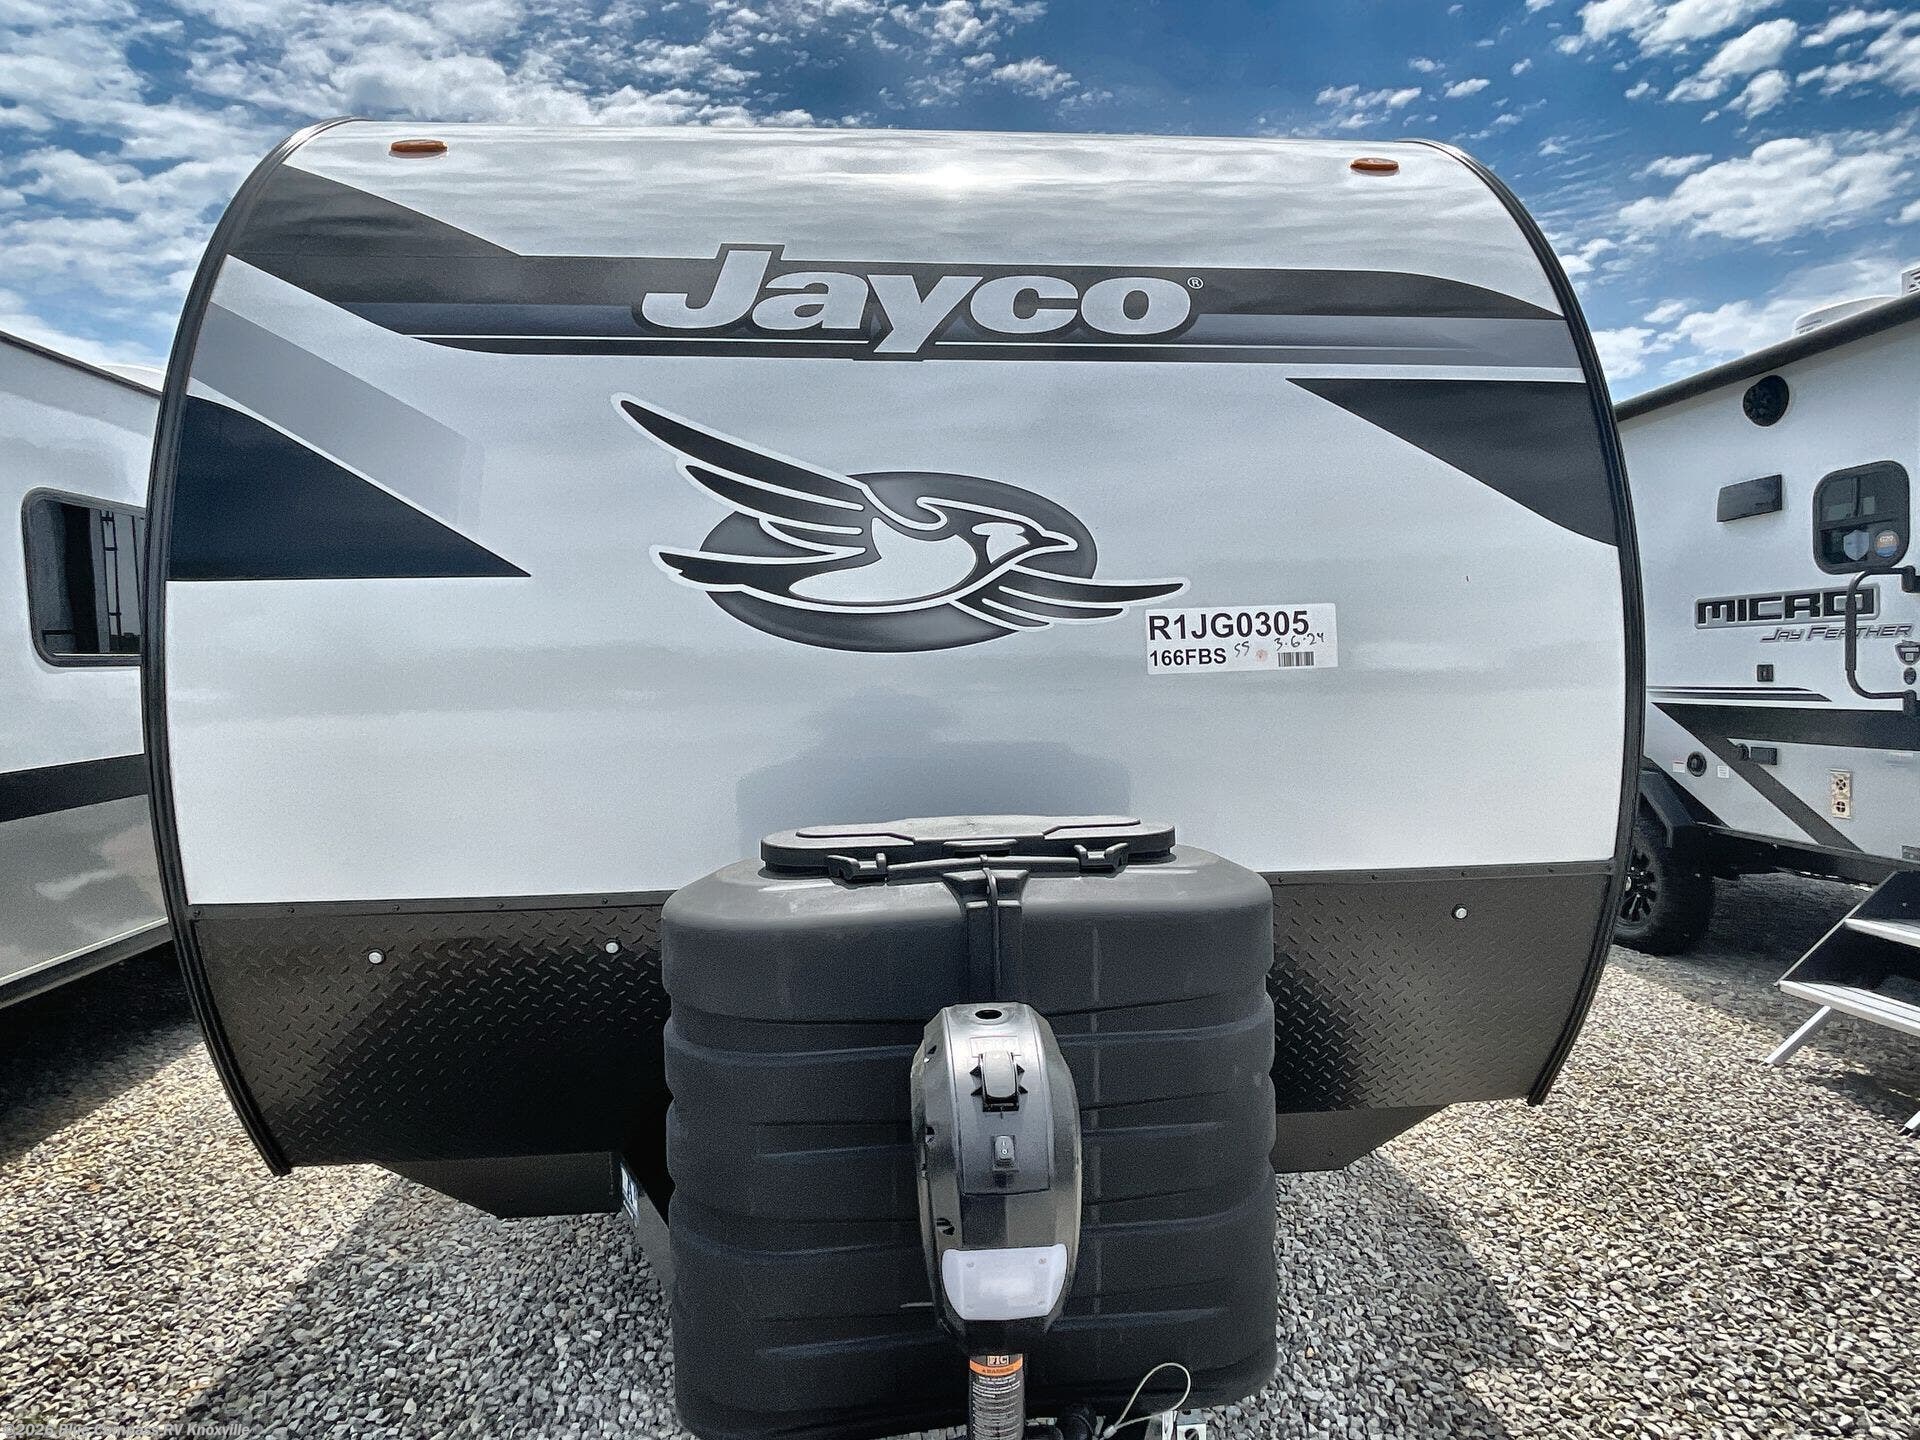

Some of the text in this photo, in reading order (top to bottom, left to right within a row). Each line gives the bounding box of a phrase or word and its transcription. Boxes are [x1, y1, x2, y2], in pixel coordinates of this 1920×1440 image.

[1697, 588, 1875, 624] MICRO
[1149, 610, 1310, 641] R1JG0305
[1149, 648, 1227, 667] 166FBS
